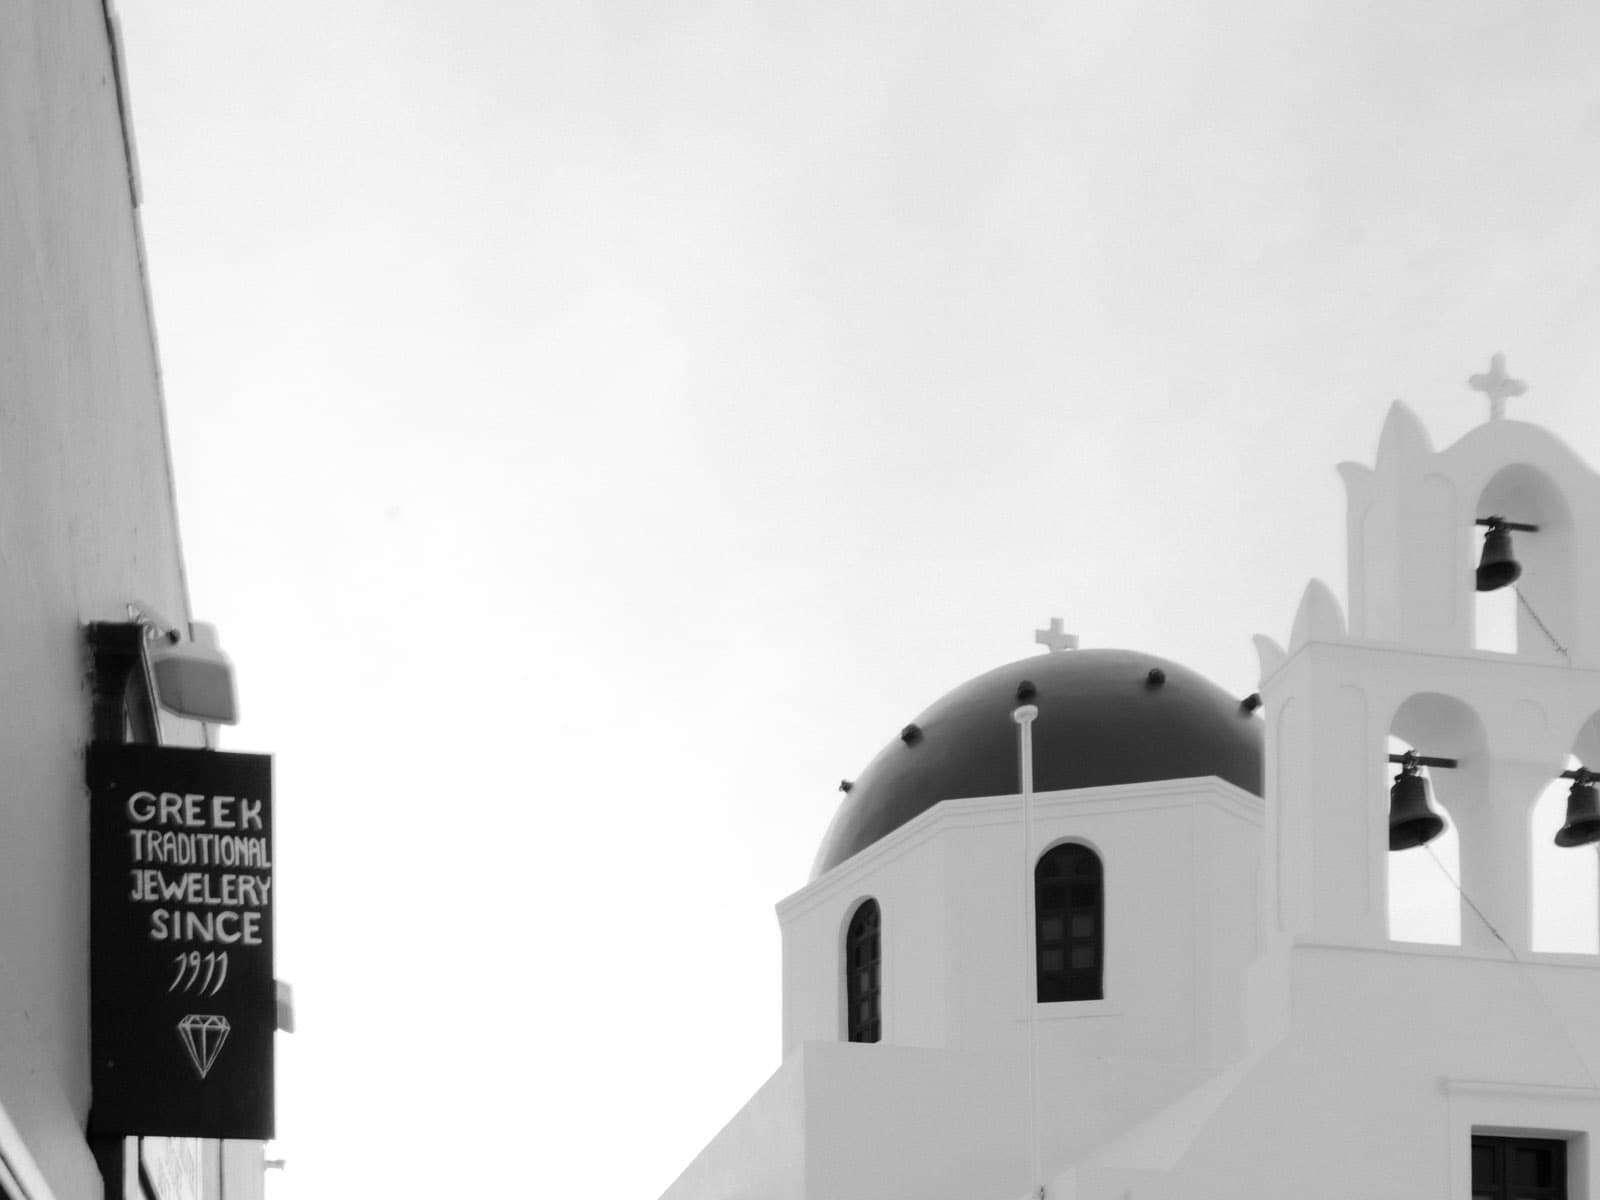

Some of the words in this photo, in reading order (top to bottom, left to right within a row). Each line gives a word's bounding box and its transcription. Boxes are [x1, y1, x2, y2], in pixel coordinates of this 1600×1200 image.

[128, 791, 263, 830] GREEK
[130, 829, 272, 868] TRADITIONAL
[131, 869, 272, 906] JEWELERY
[150, 909, 262, 945] SINCE
